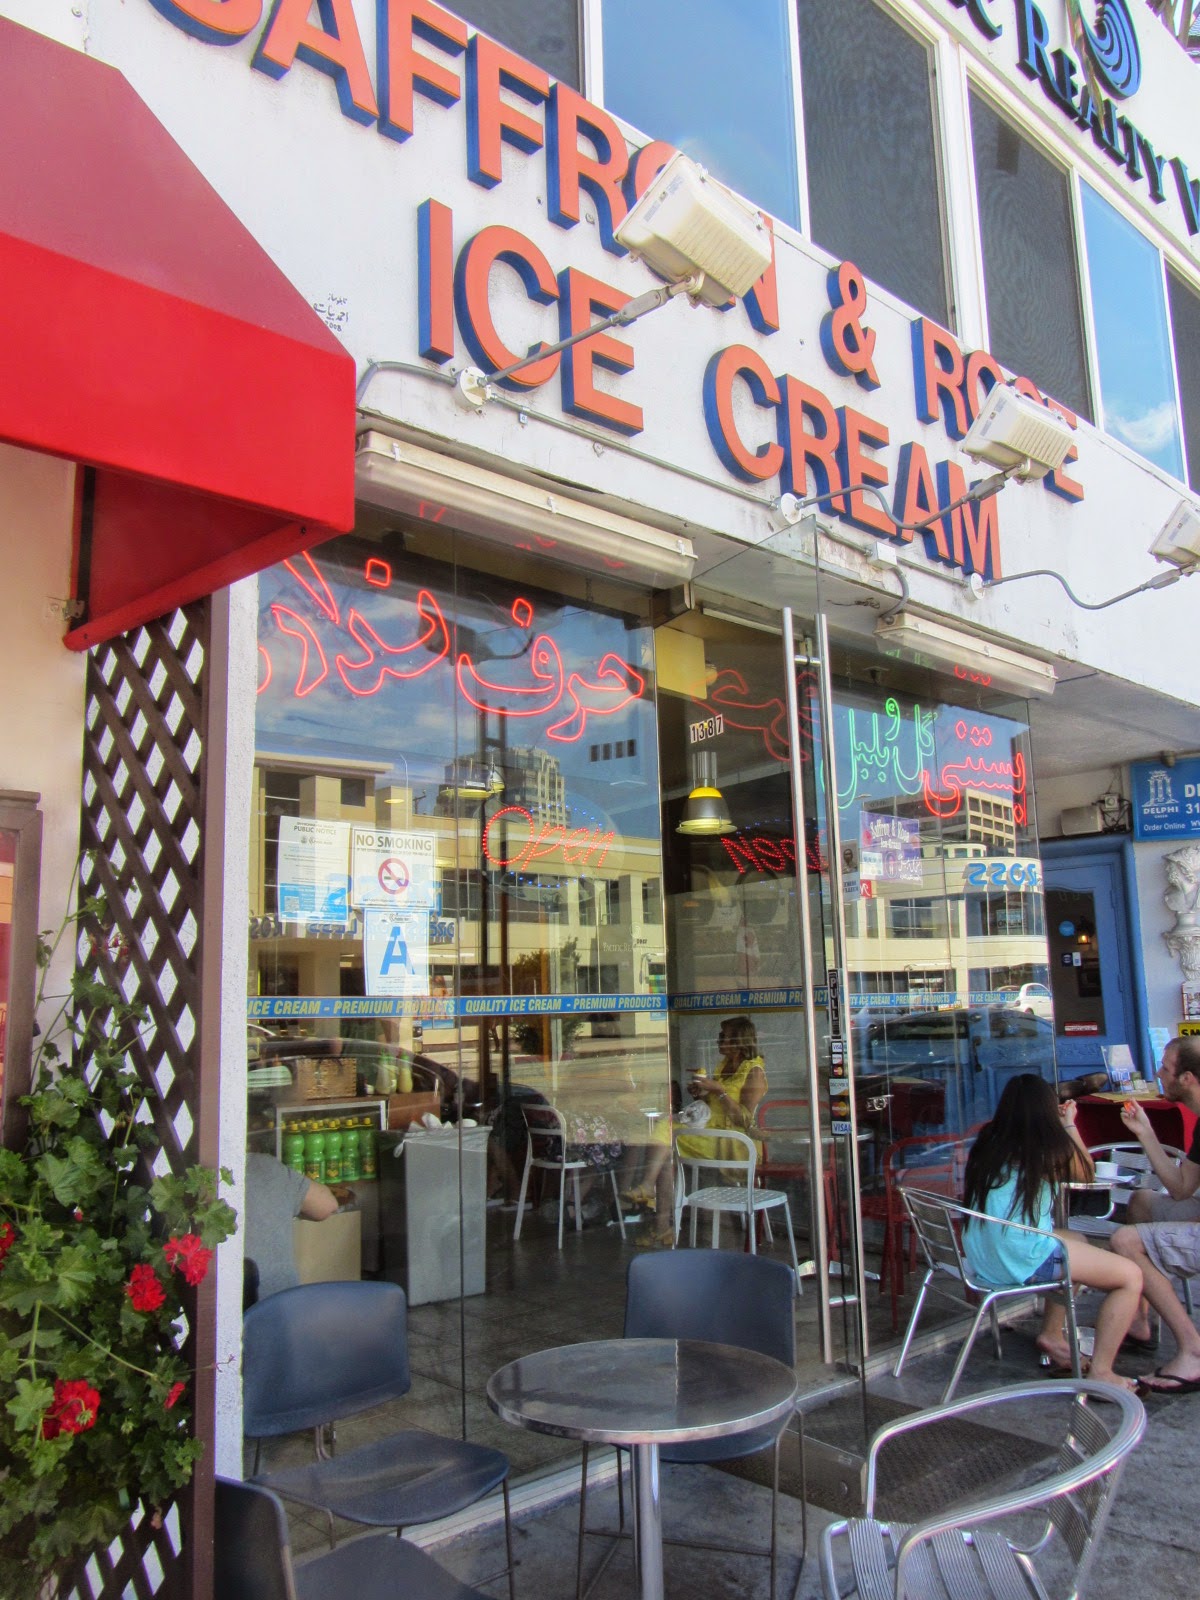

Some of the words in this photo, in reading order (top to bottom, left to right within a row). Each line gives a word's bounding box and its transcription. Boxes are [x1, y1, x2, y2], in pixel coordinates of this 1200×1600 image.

[147, 0, 780, 336] AFFRN
[820, 261, 881, 392] &
[911, 317, 1085, 503] RO
[417, 197, 643, 437] ICE
[703, 344, 1003, 581] CREAM
[257, 550, 451, 698] ندار
[455, 597, 646, 743] حرف
[690, 714, 725, 744] 1387
[1143, 806, 1179, 815] DELPHI
[293, 825, 315, 833] PUBLIC
[315, 827, 337, 836] NOTICE
[1143, 823, 1163, 832] Order
[1163, 822, 1186, 831] Online
[356, 834, 375, 848] NO
[377, 836, 433, 852] SMOKING
[482, 805, 616, 872] Open
[379, 925, 416, 976] A
[247, 1000, 271, 1015] ICE
[273, 1000, 320, 1015] CREAM
[333, 1000, 394, 1014] PREMIUM
[395, 999, 456, 1014] PRODUCTS
[465, 999, 508, 1012] QUALITY
[509, 999, 526, 1012] ICE
[528, 998, 562, 1011] CREAM
[573, 997, 617, 1010] PREMIUM
[618, 996, 662, 1009] PRODUCTS
[674, 997, 700, 1009] QUALITY
[701, 995, 714, 1007] ICE
[715, 993, 742, 1006] CREAM
[749, 990, 787, 1005] PREMIUM
[830, 977, 839, 1021] PULL
[859, 995, 869, 1005] ICE
[870, 995, 890, 1005] CREAM
[833, 1123, 851, 1133] VISA
